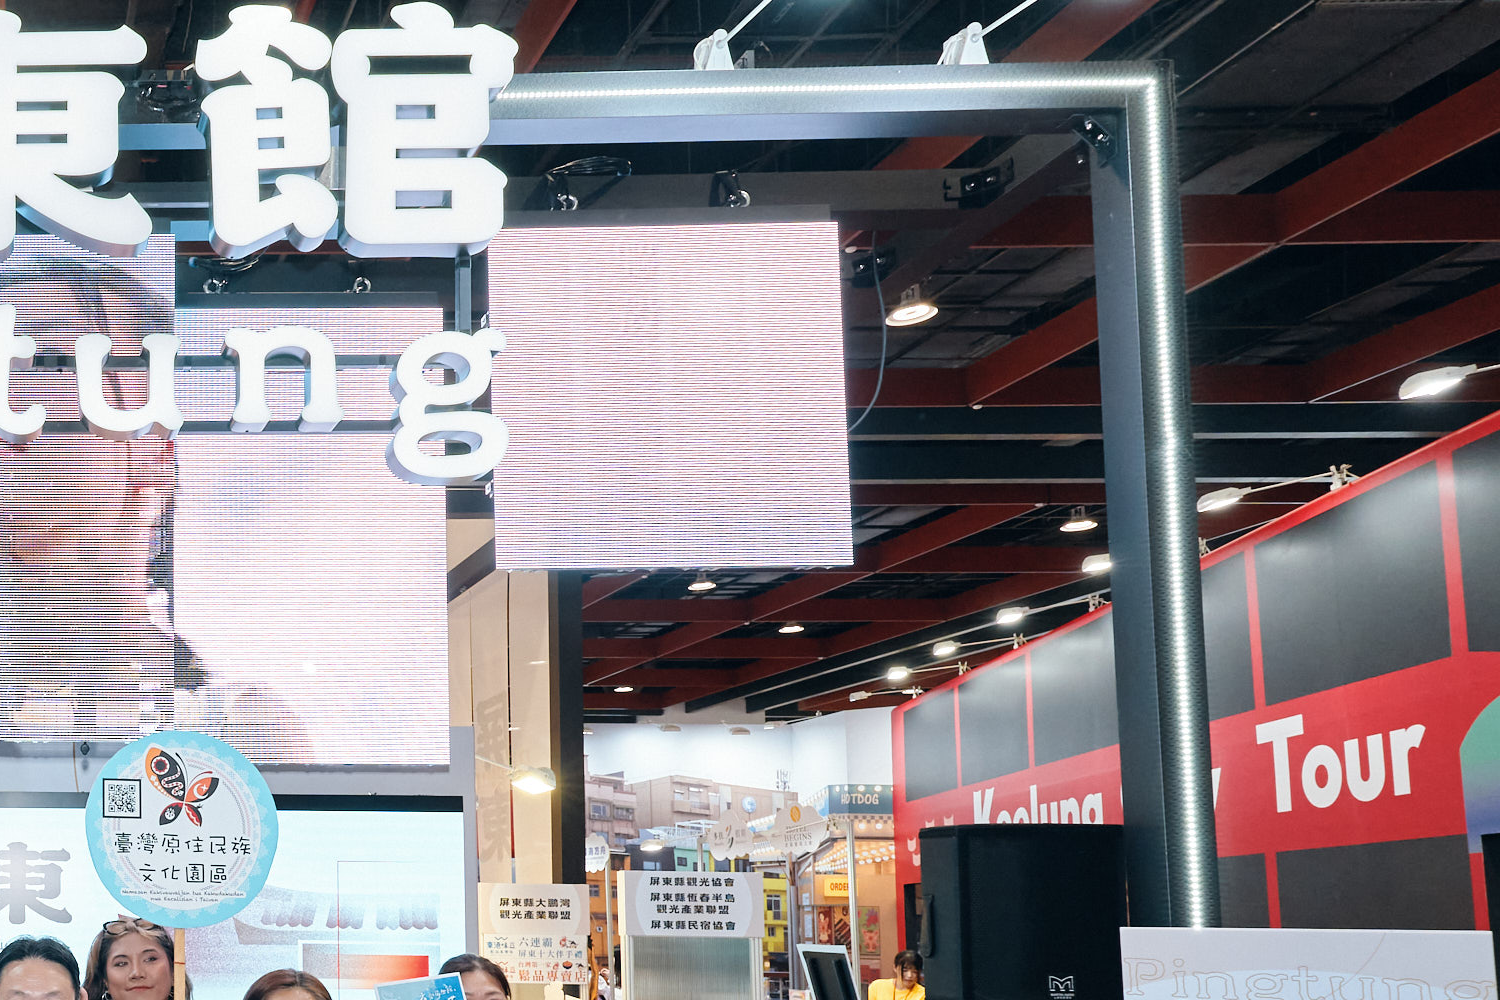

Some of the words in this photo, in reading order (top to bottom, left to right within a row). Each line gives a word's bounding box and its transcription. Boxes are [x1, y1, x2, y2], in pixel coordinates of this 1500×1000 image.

[1256, 713, 1427, 813] Tour
[840, 793, 880, 806] HOTDOG
[114, 832, 251, 855] 臺灣原住民族
[139, 863, 227, 883] 文化園區
[649, 876, 735, 887] 屏東縣觀光協會
[499, 897, 571, 908] 屏東縣大鵬灣
[649, 892, 736, 903] 屏東縣恆春半島
[499, 909, 571, 920] 觀光產業聯盟
[656, 904, 729, 914] 觀光產業聯盟
[650, 920, 736, 930] 屏東縣民宿協會
[519, 936, 553, 948] 六連霸
